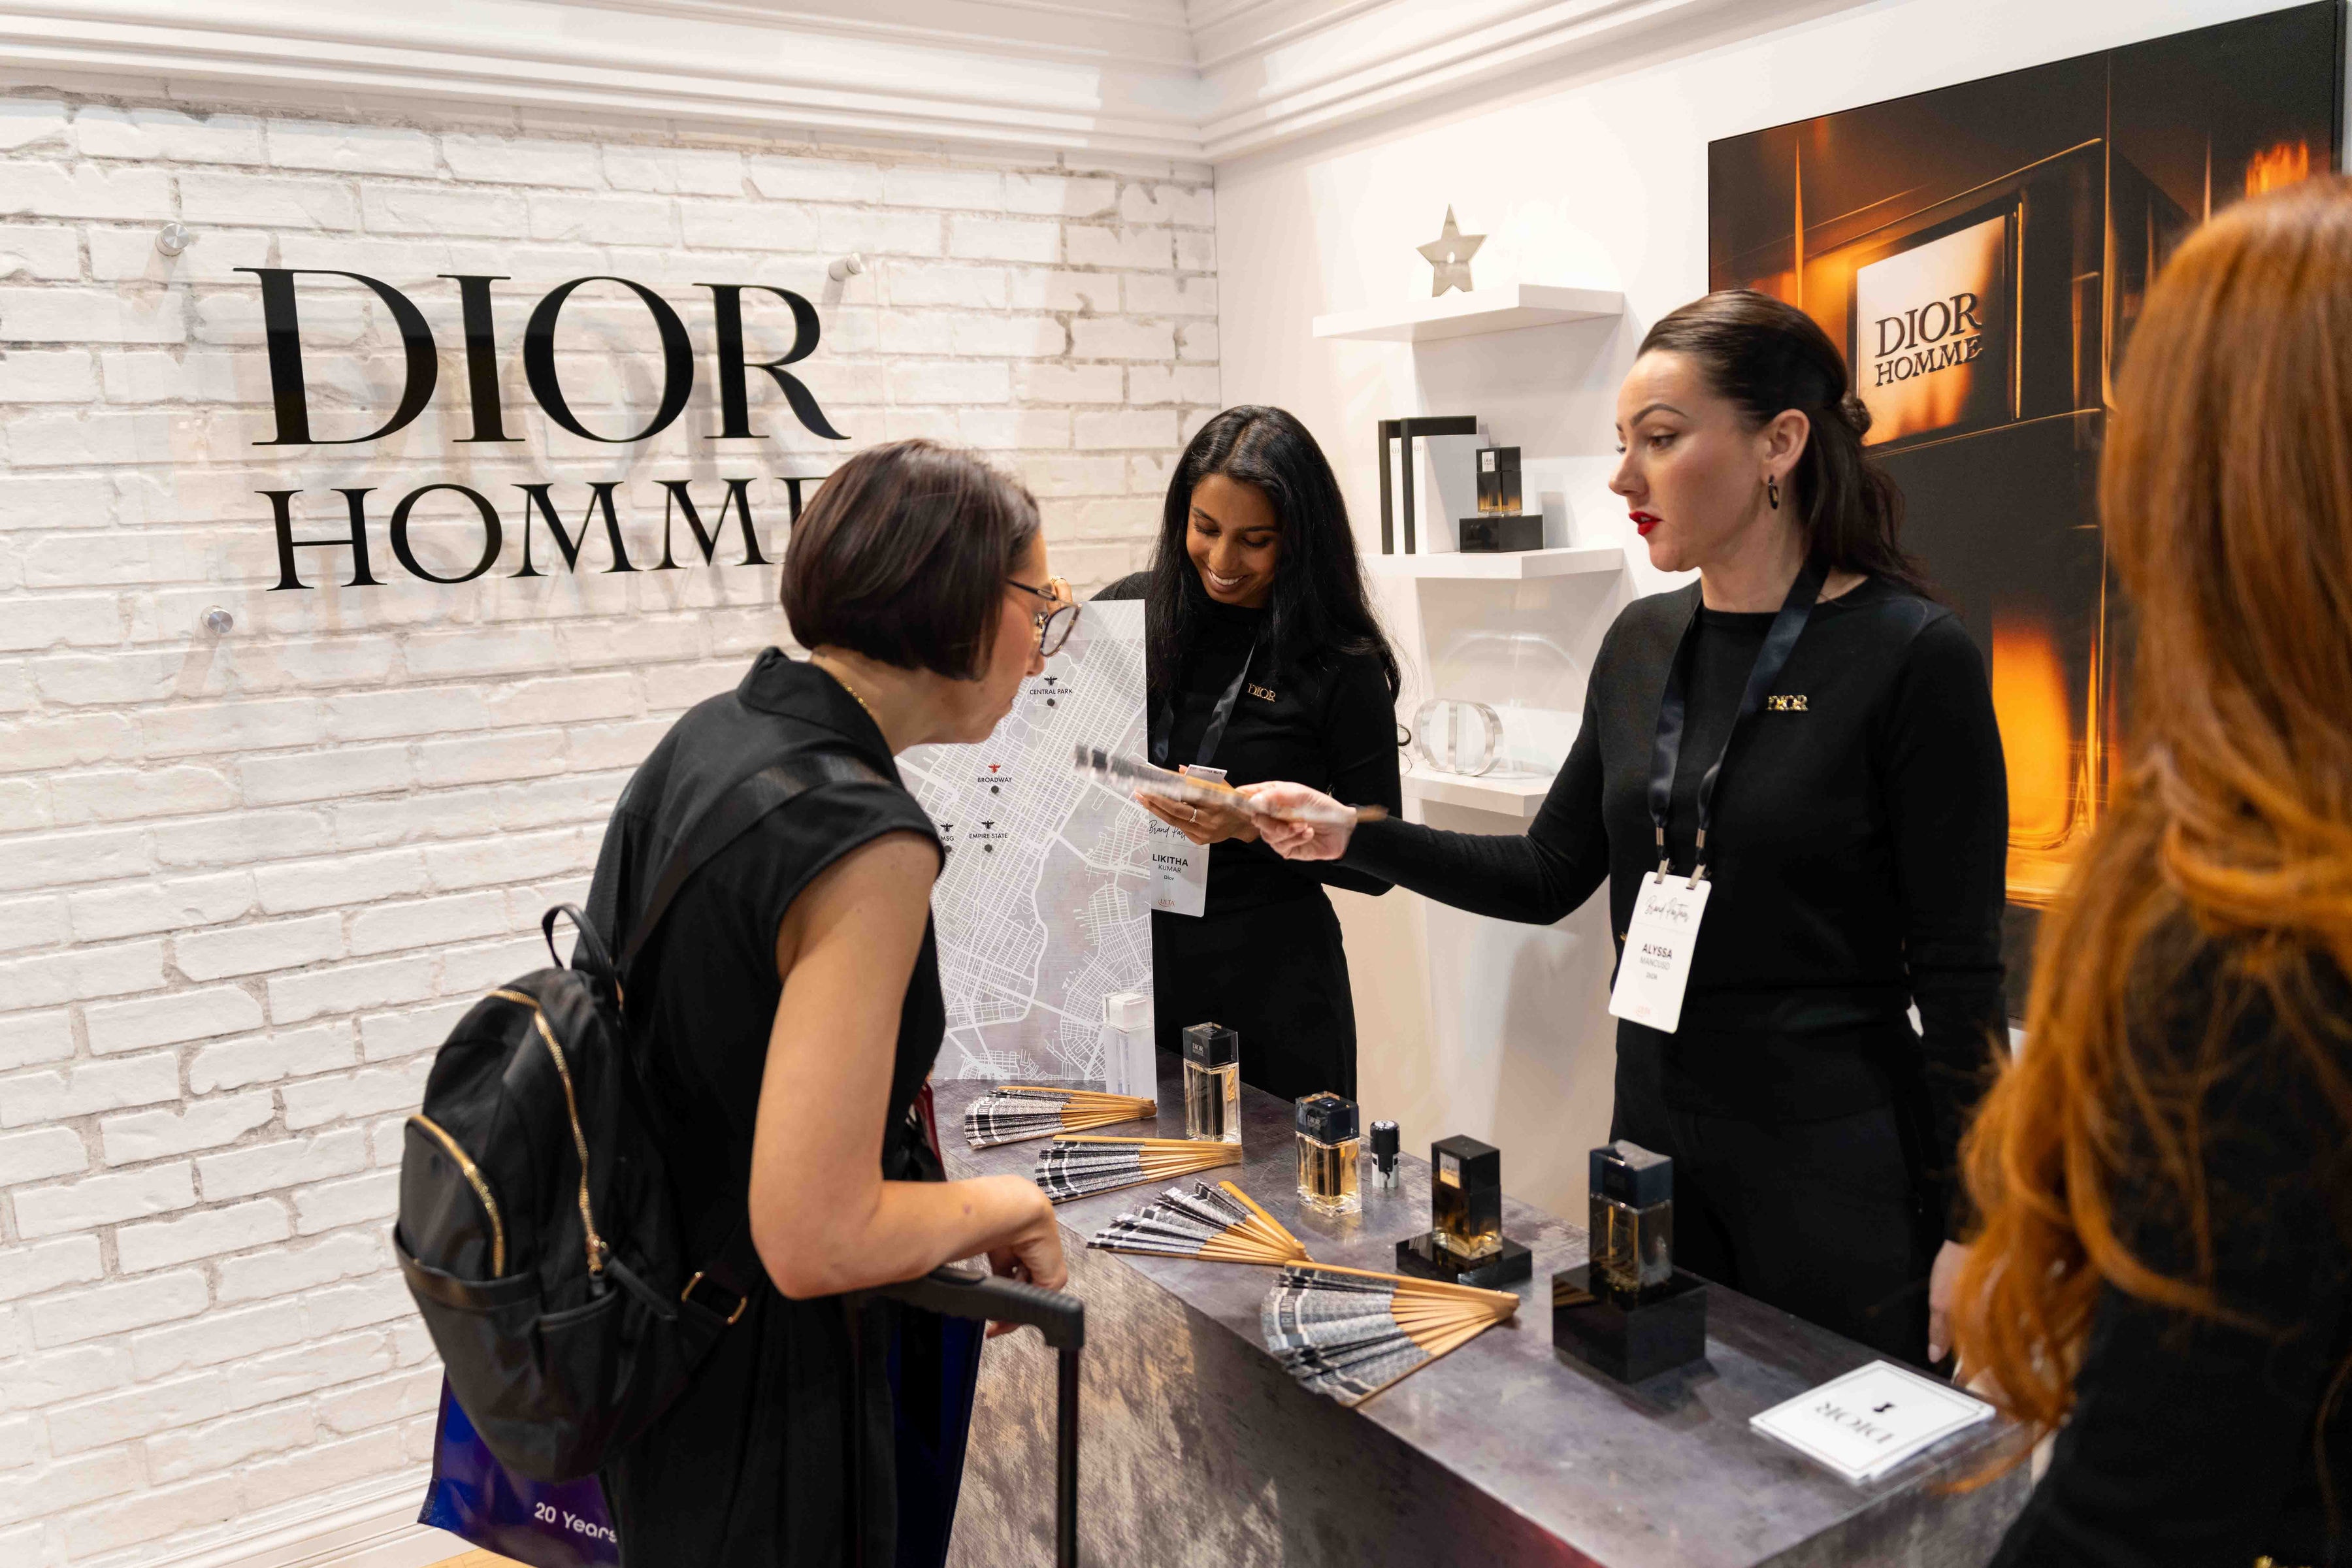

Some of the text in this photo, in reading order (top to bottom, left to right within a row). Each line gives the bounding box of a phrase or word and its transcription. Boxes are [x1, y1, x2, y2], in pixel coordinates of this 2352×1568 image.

[1875, 293, 1982, 357] DIOR
[233, 267, 851, 446] DIOR
[1874, 333, 1984, 387] HOMME
[1249, 683, 1276, 702] DIOR
[1149, 820, 1169, 838] Brand
[1152, 853, 1188, 867] LIKITHA
[1158, 865, 1181, 874] KUMAR
[1160, 898, 1175, 907] ULTA
[1642, 943, 1673, 959] ALYSSA
[534, 1503, 617, 1543] 20 Years
